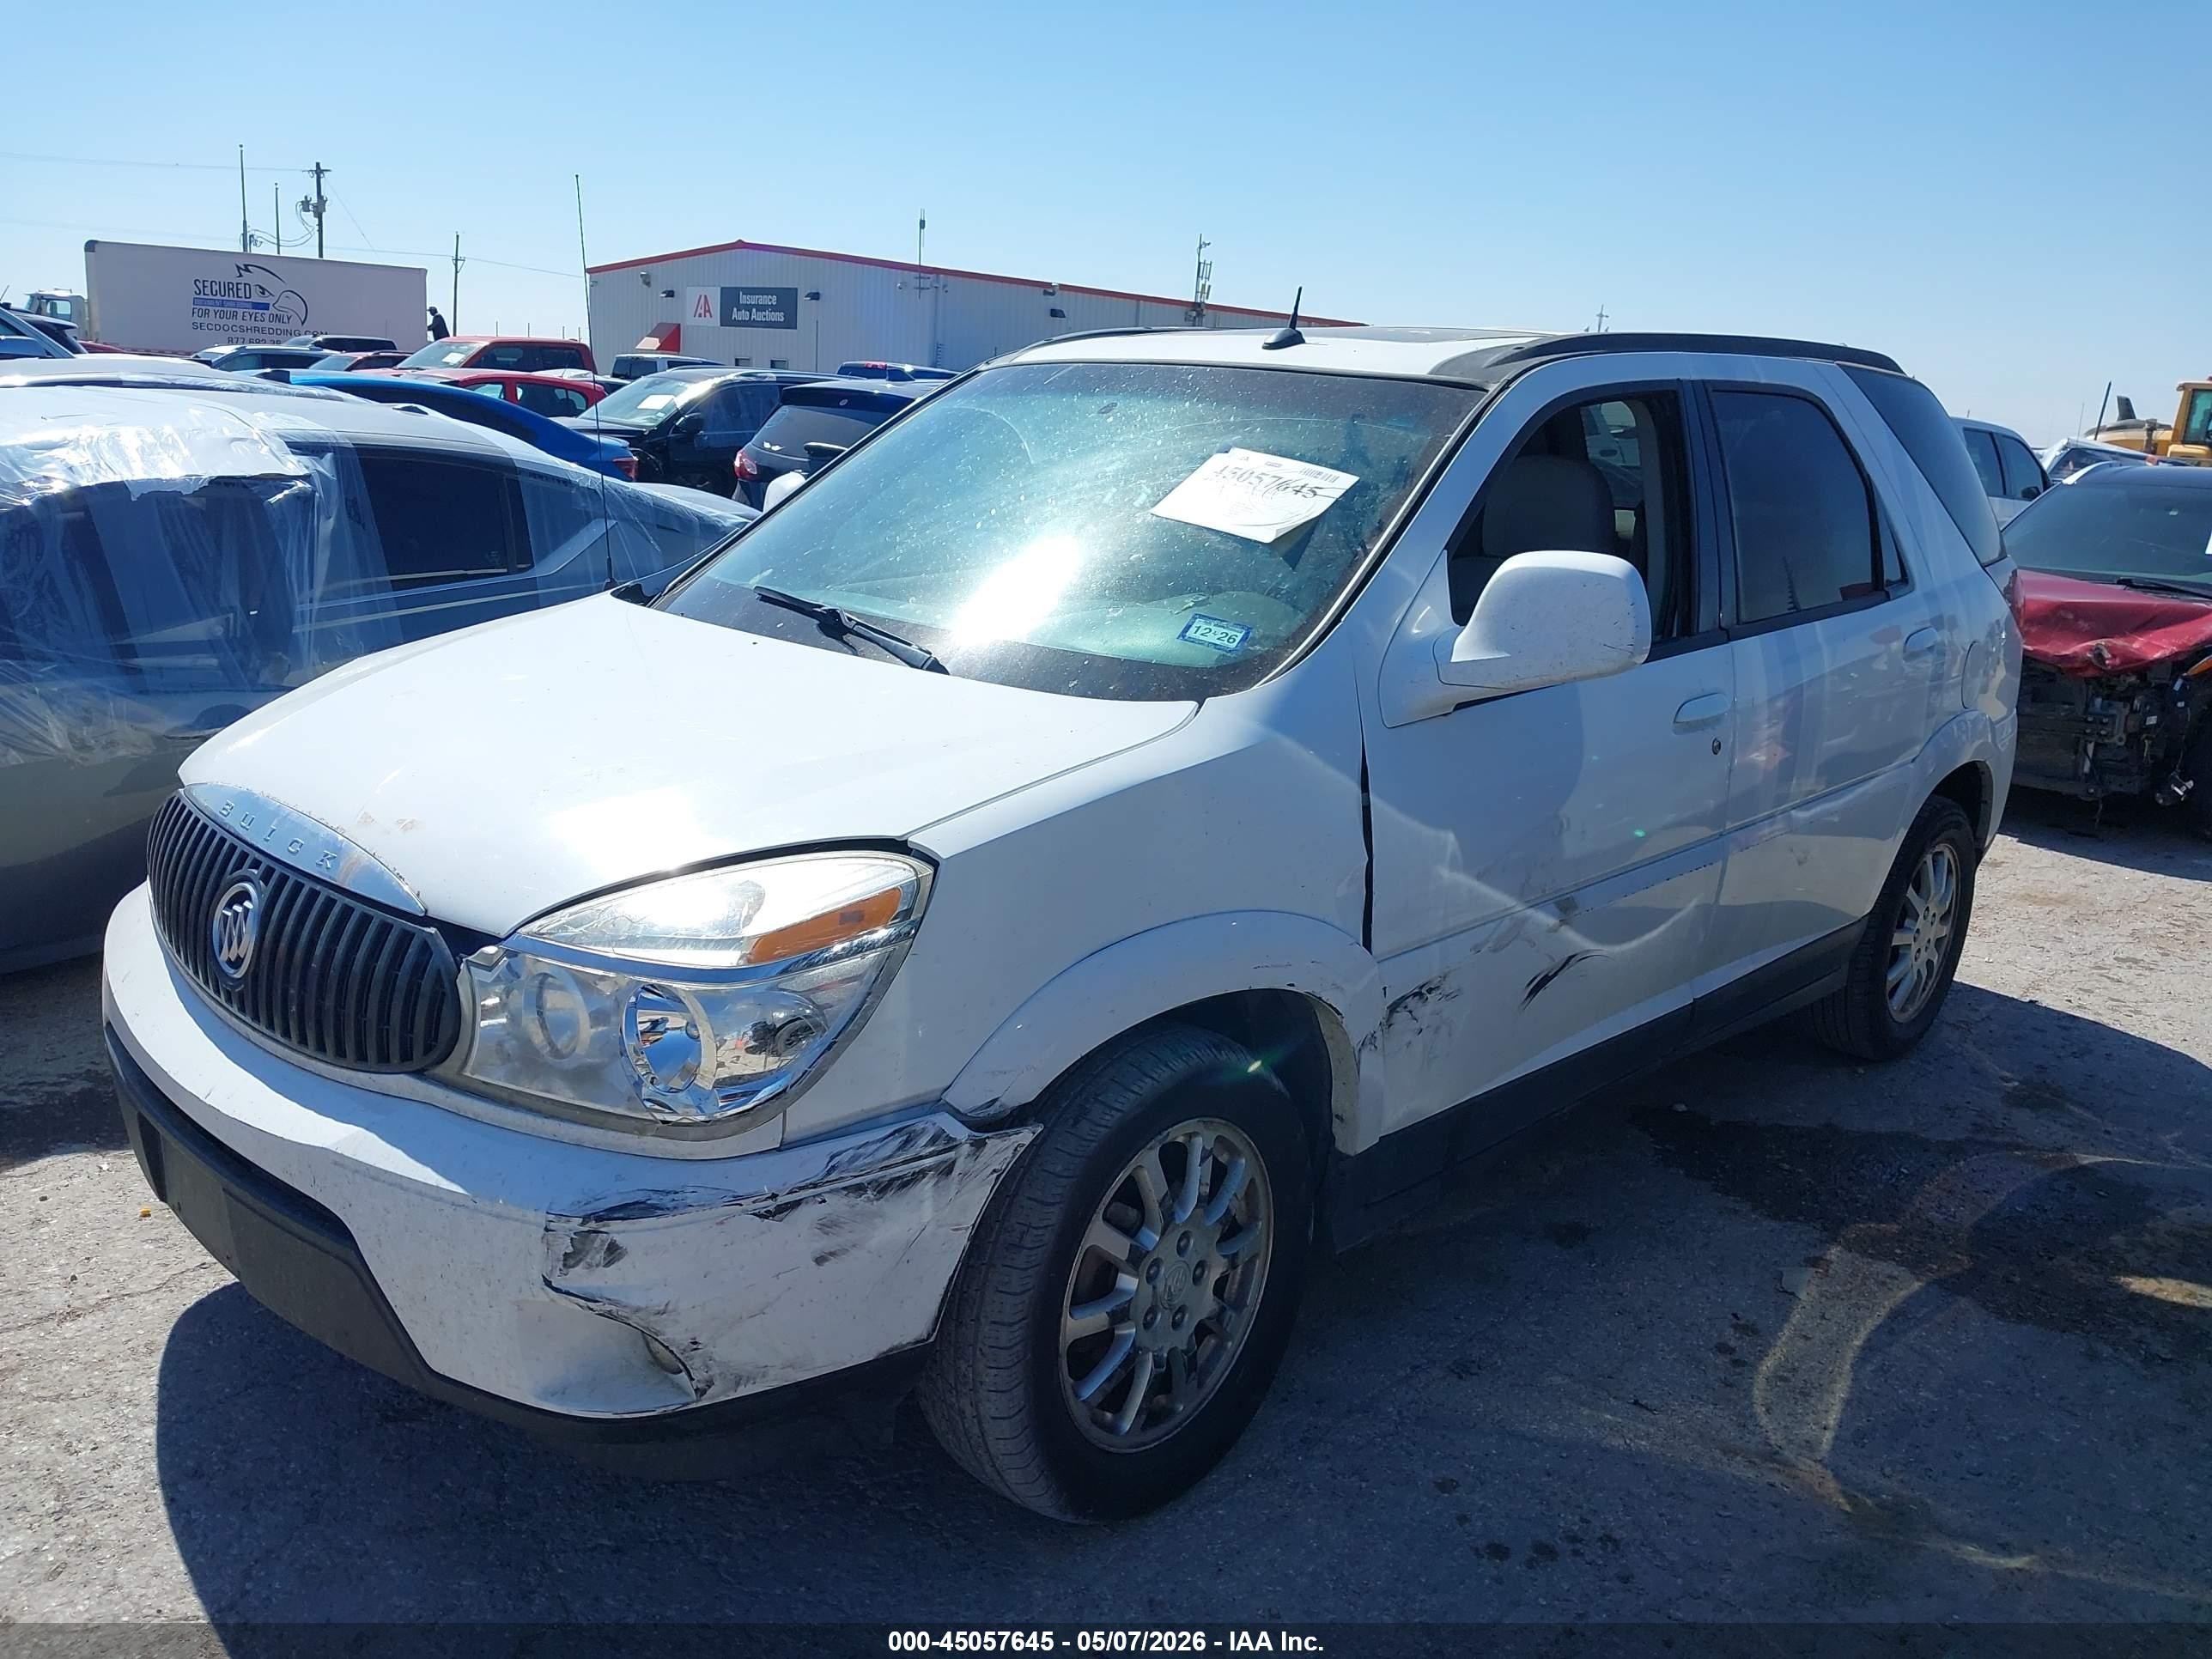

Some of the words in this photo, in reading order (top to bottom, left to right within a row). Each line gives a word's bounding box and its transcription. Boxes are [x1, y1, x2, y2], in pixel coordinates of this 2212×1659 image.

[193, 279, 252, 299] SECURED
[739, 291, 777, 305] Insurance
[191, 307, 210, 319] FOR
[214, 309, 238, 320] YOUR
[242, 311, 265, 322] EYES
[268, 313, 293, 324] ONLY
[732, 307, 750, 320] Auto
[750, 308, 785, 322] Auctions
[1193, 625, 1212, 637] 12
[1217, 631, 1238, 644] 26
[219, 799, 337, 869] BUICK
